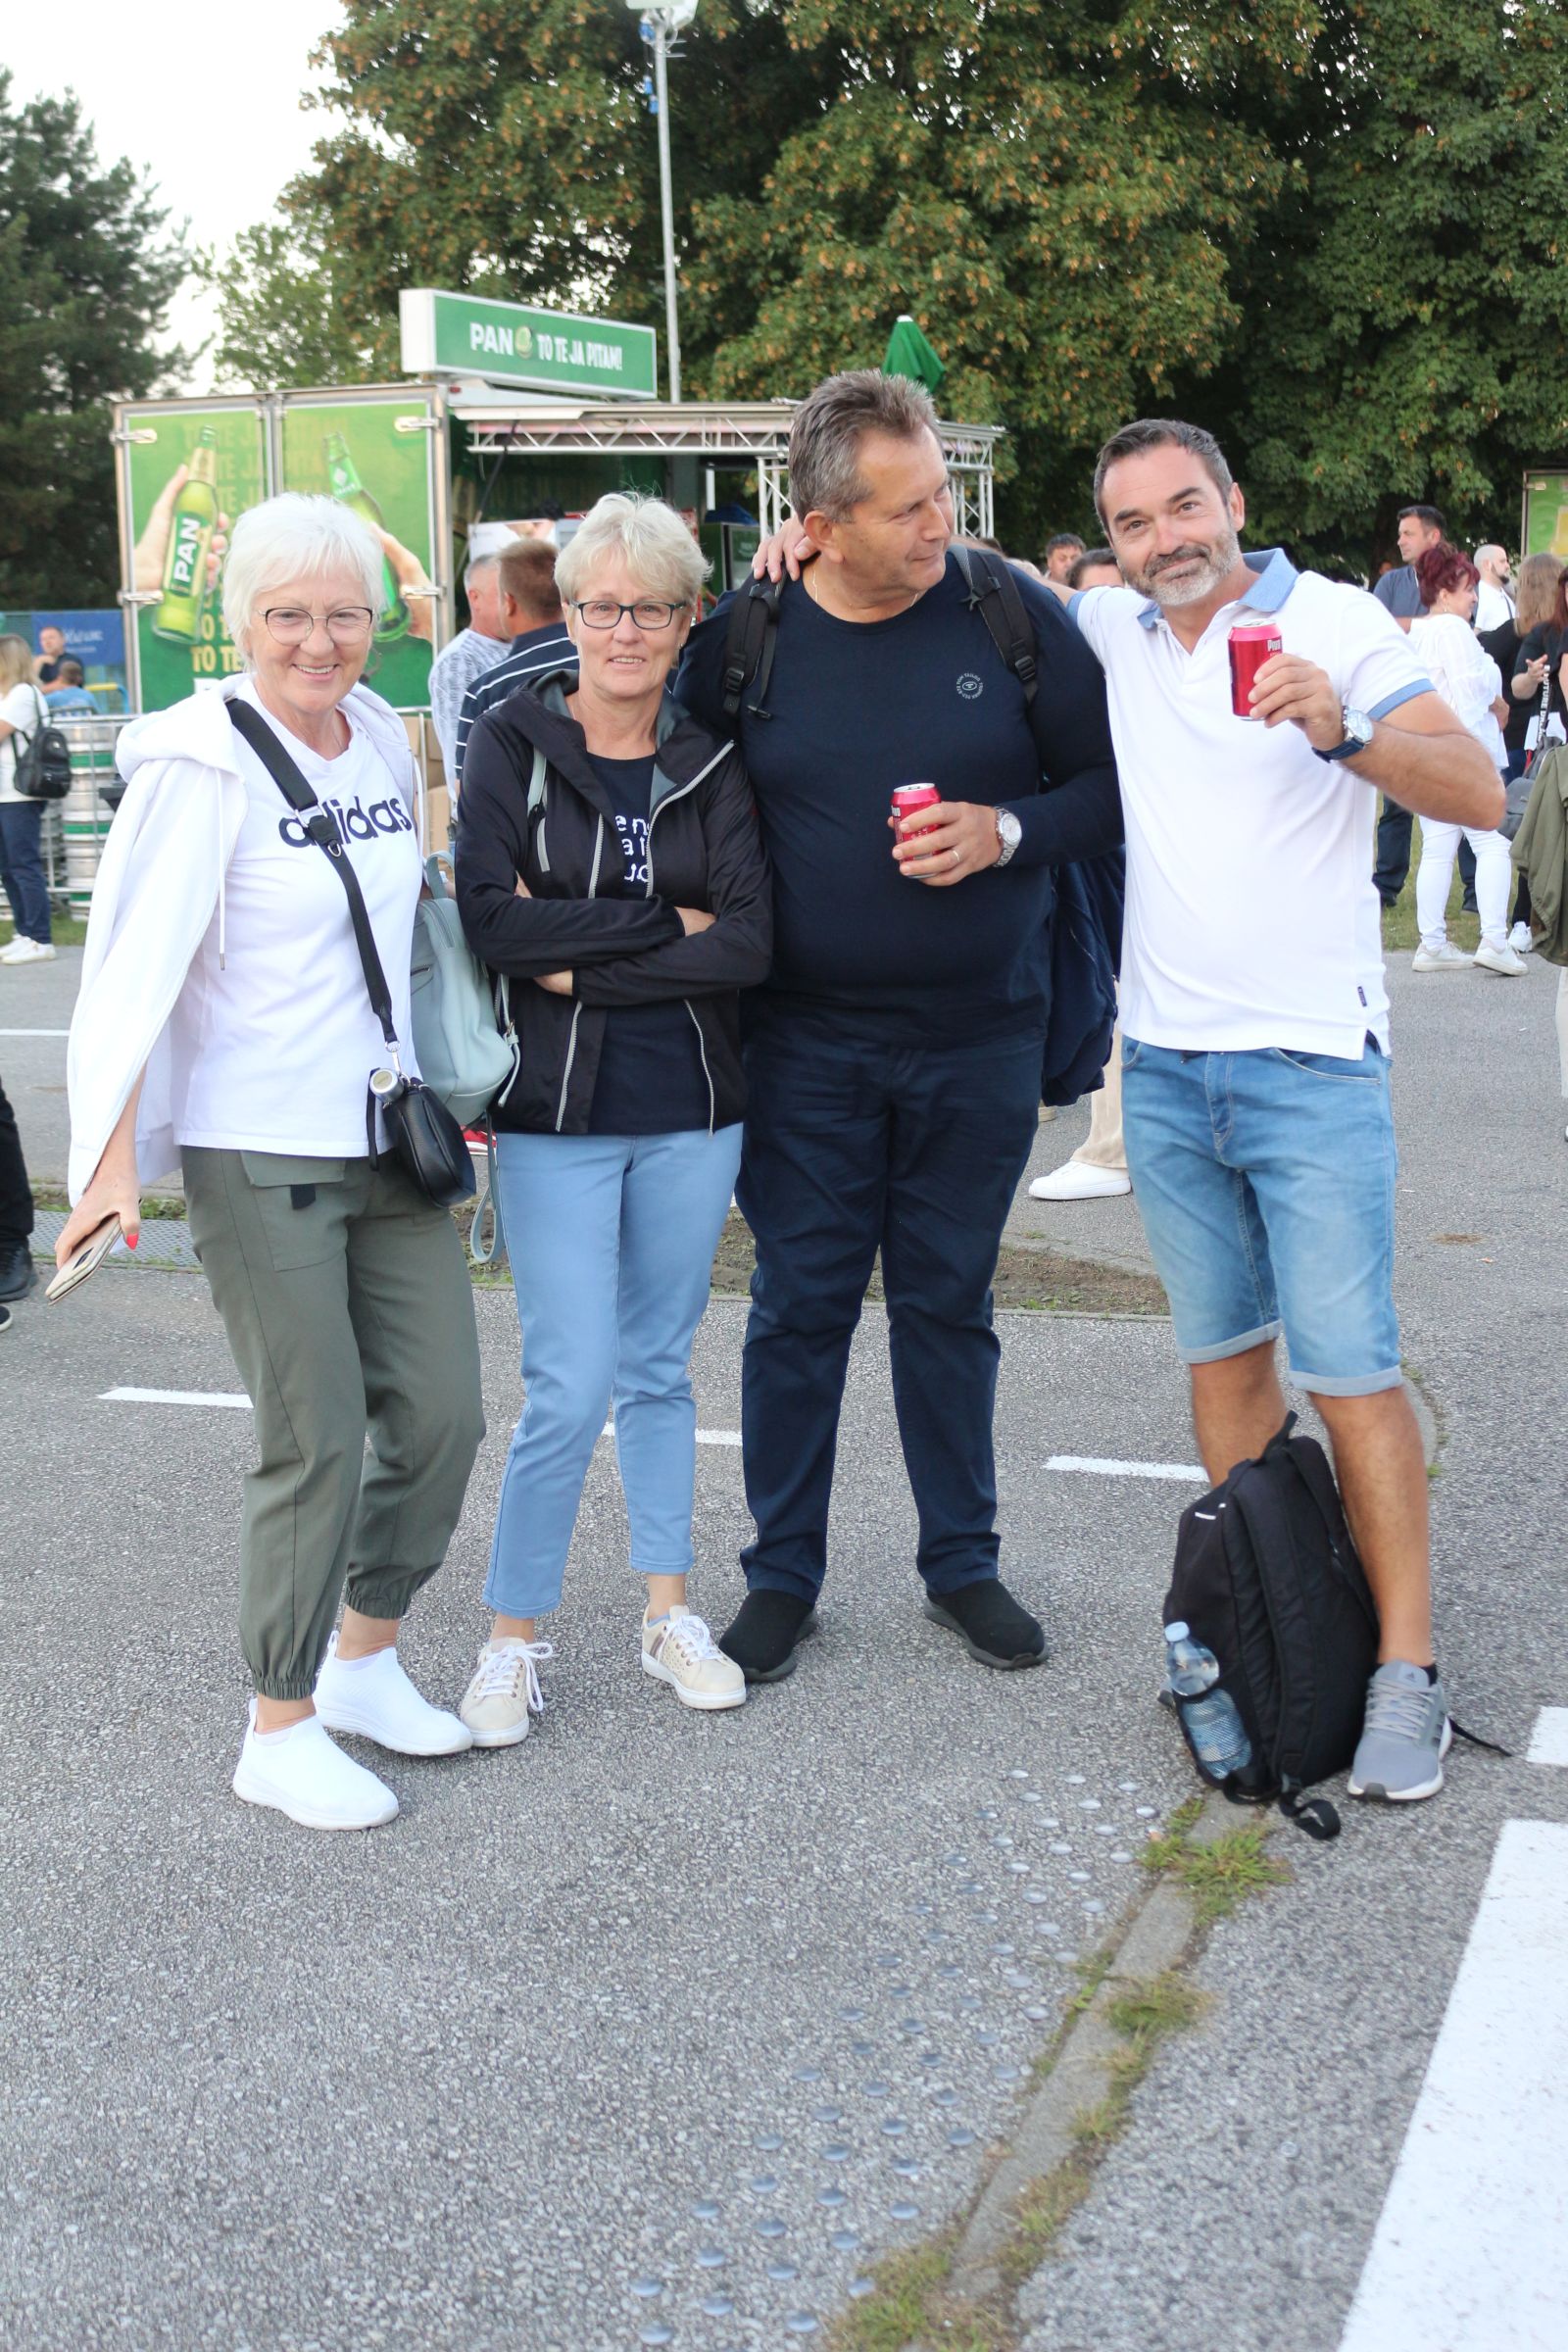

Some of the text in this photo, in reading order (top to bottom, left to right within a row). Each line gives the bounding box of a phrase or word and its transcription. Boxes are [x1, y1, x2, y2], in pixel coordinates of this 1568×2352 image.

[469, 321, 514, 356] PAN
[536, 333, 553, 361] TO
[554, 335, 568, 364] TE
[568, 339, 585, 367] JA
[173, 517, 201, 582] PAN
[190, 644, 217, 672] TO
